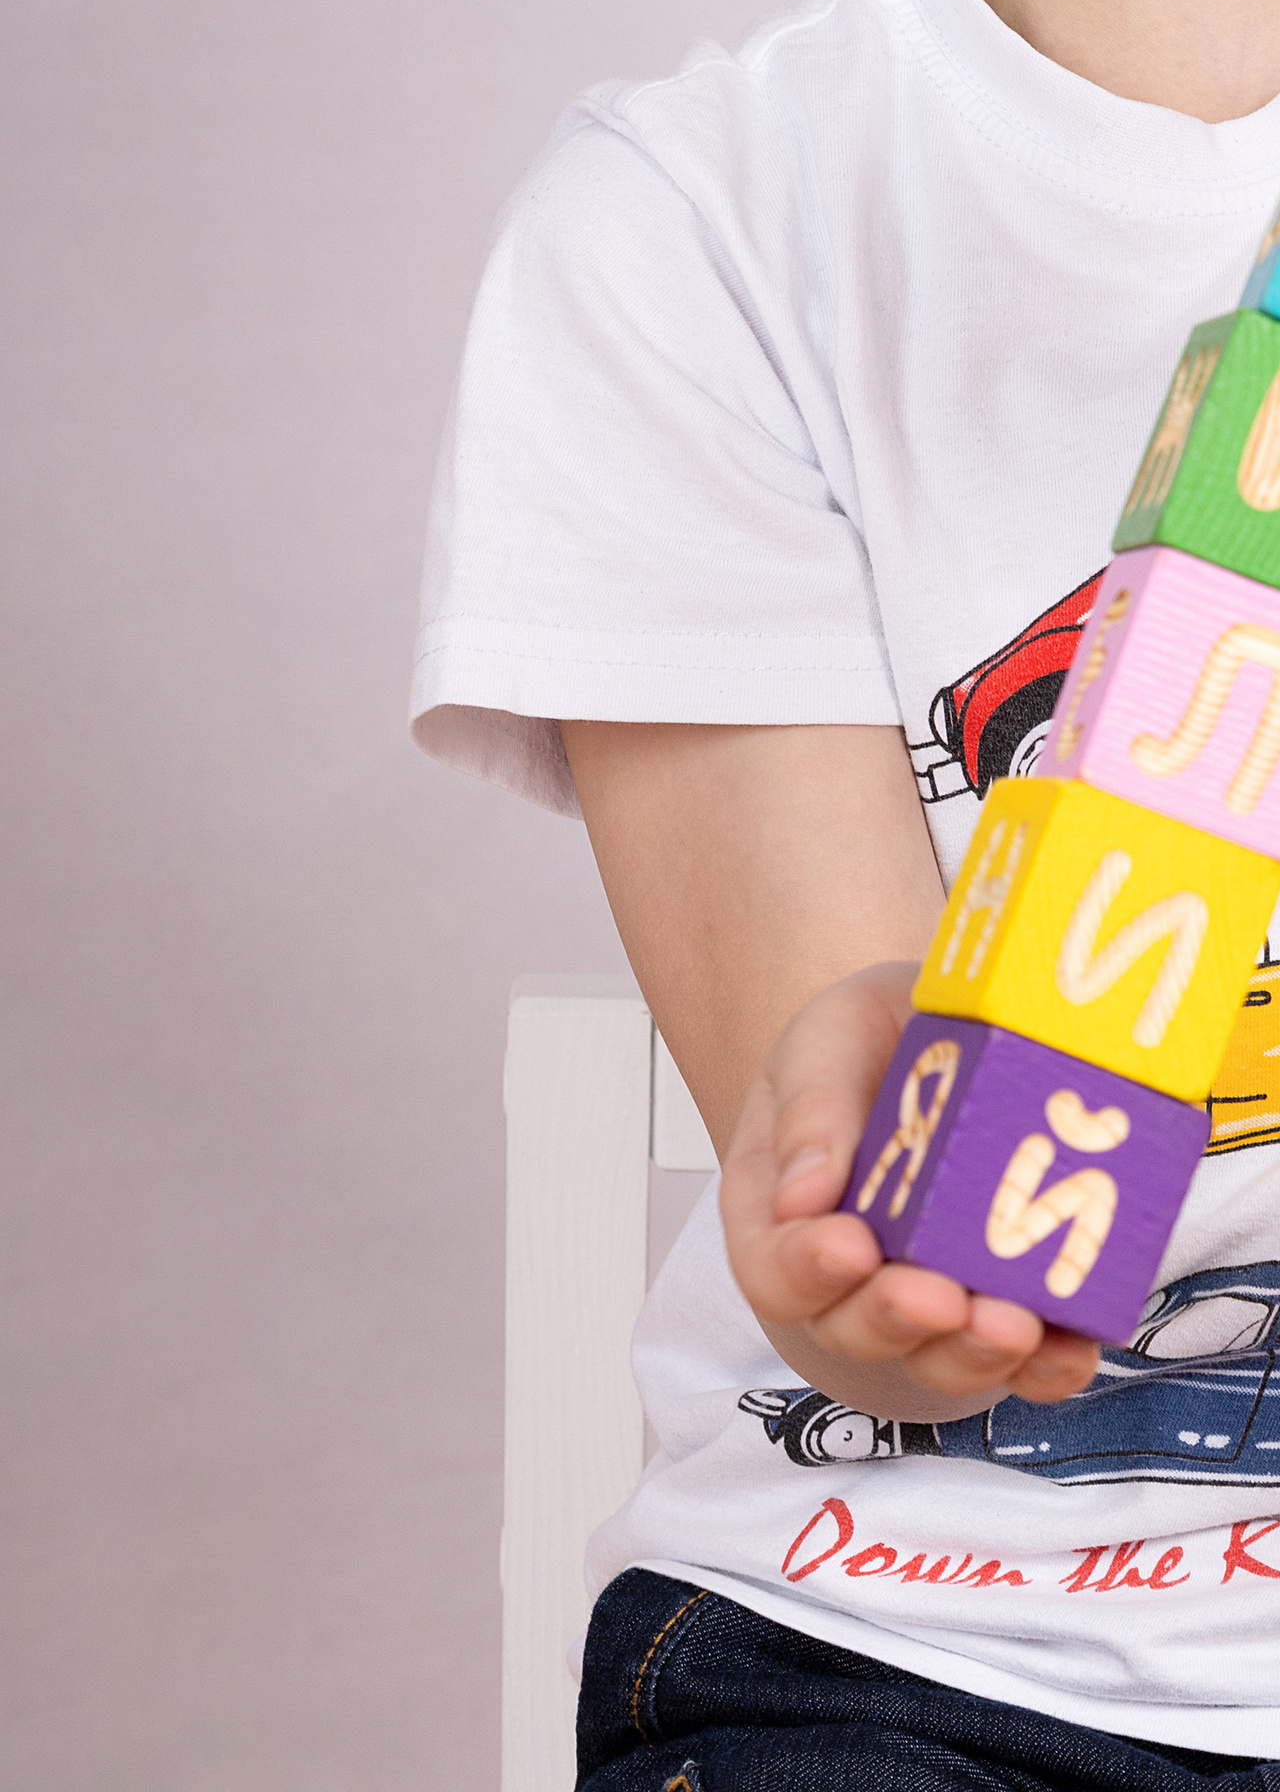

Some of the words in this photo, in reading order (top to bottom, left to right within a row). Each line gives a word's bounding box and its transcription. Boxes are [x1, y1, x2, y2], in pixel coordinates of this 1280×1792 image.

[985, 1088, 1131, 1299] Й
[781, 1497, 1033, 1587] Down
[1059, 1539, 1191, 1594] the
